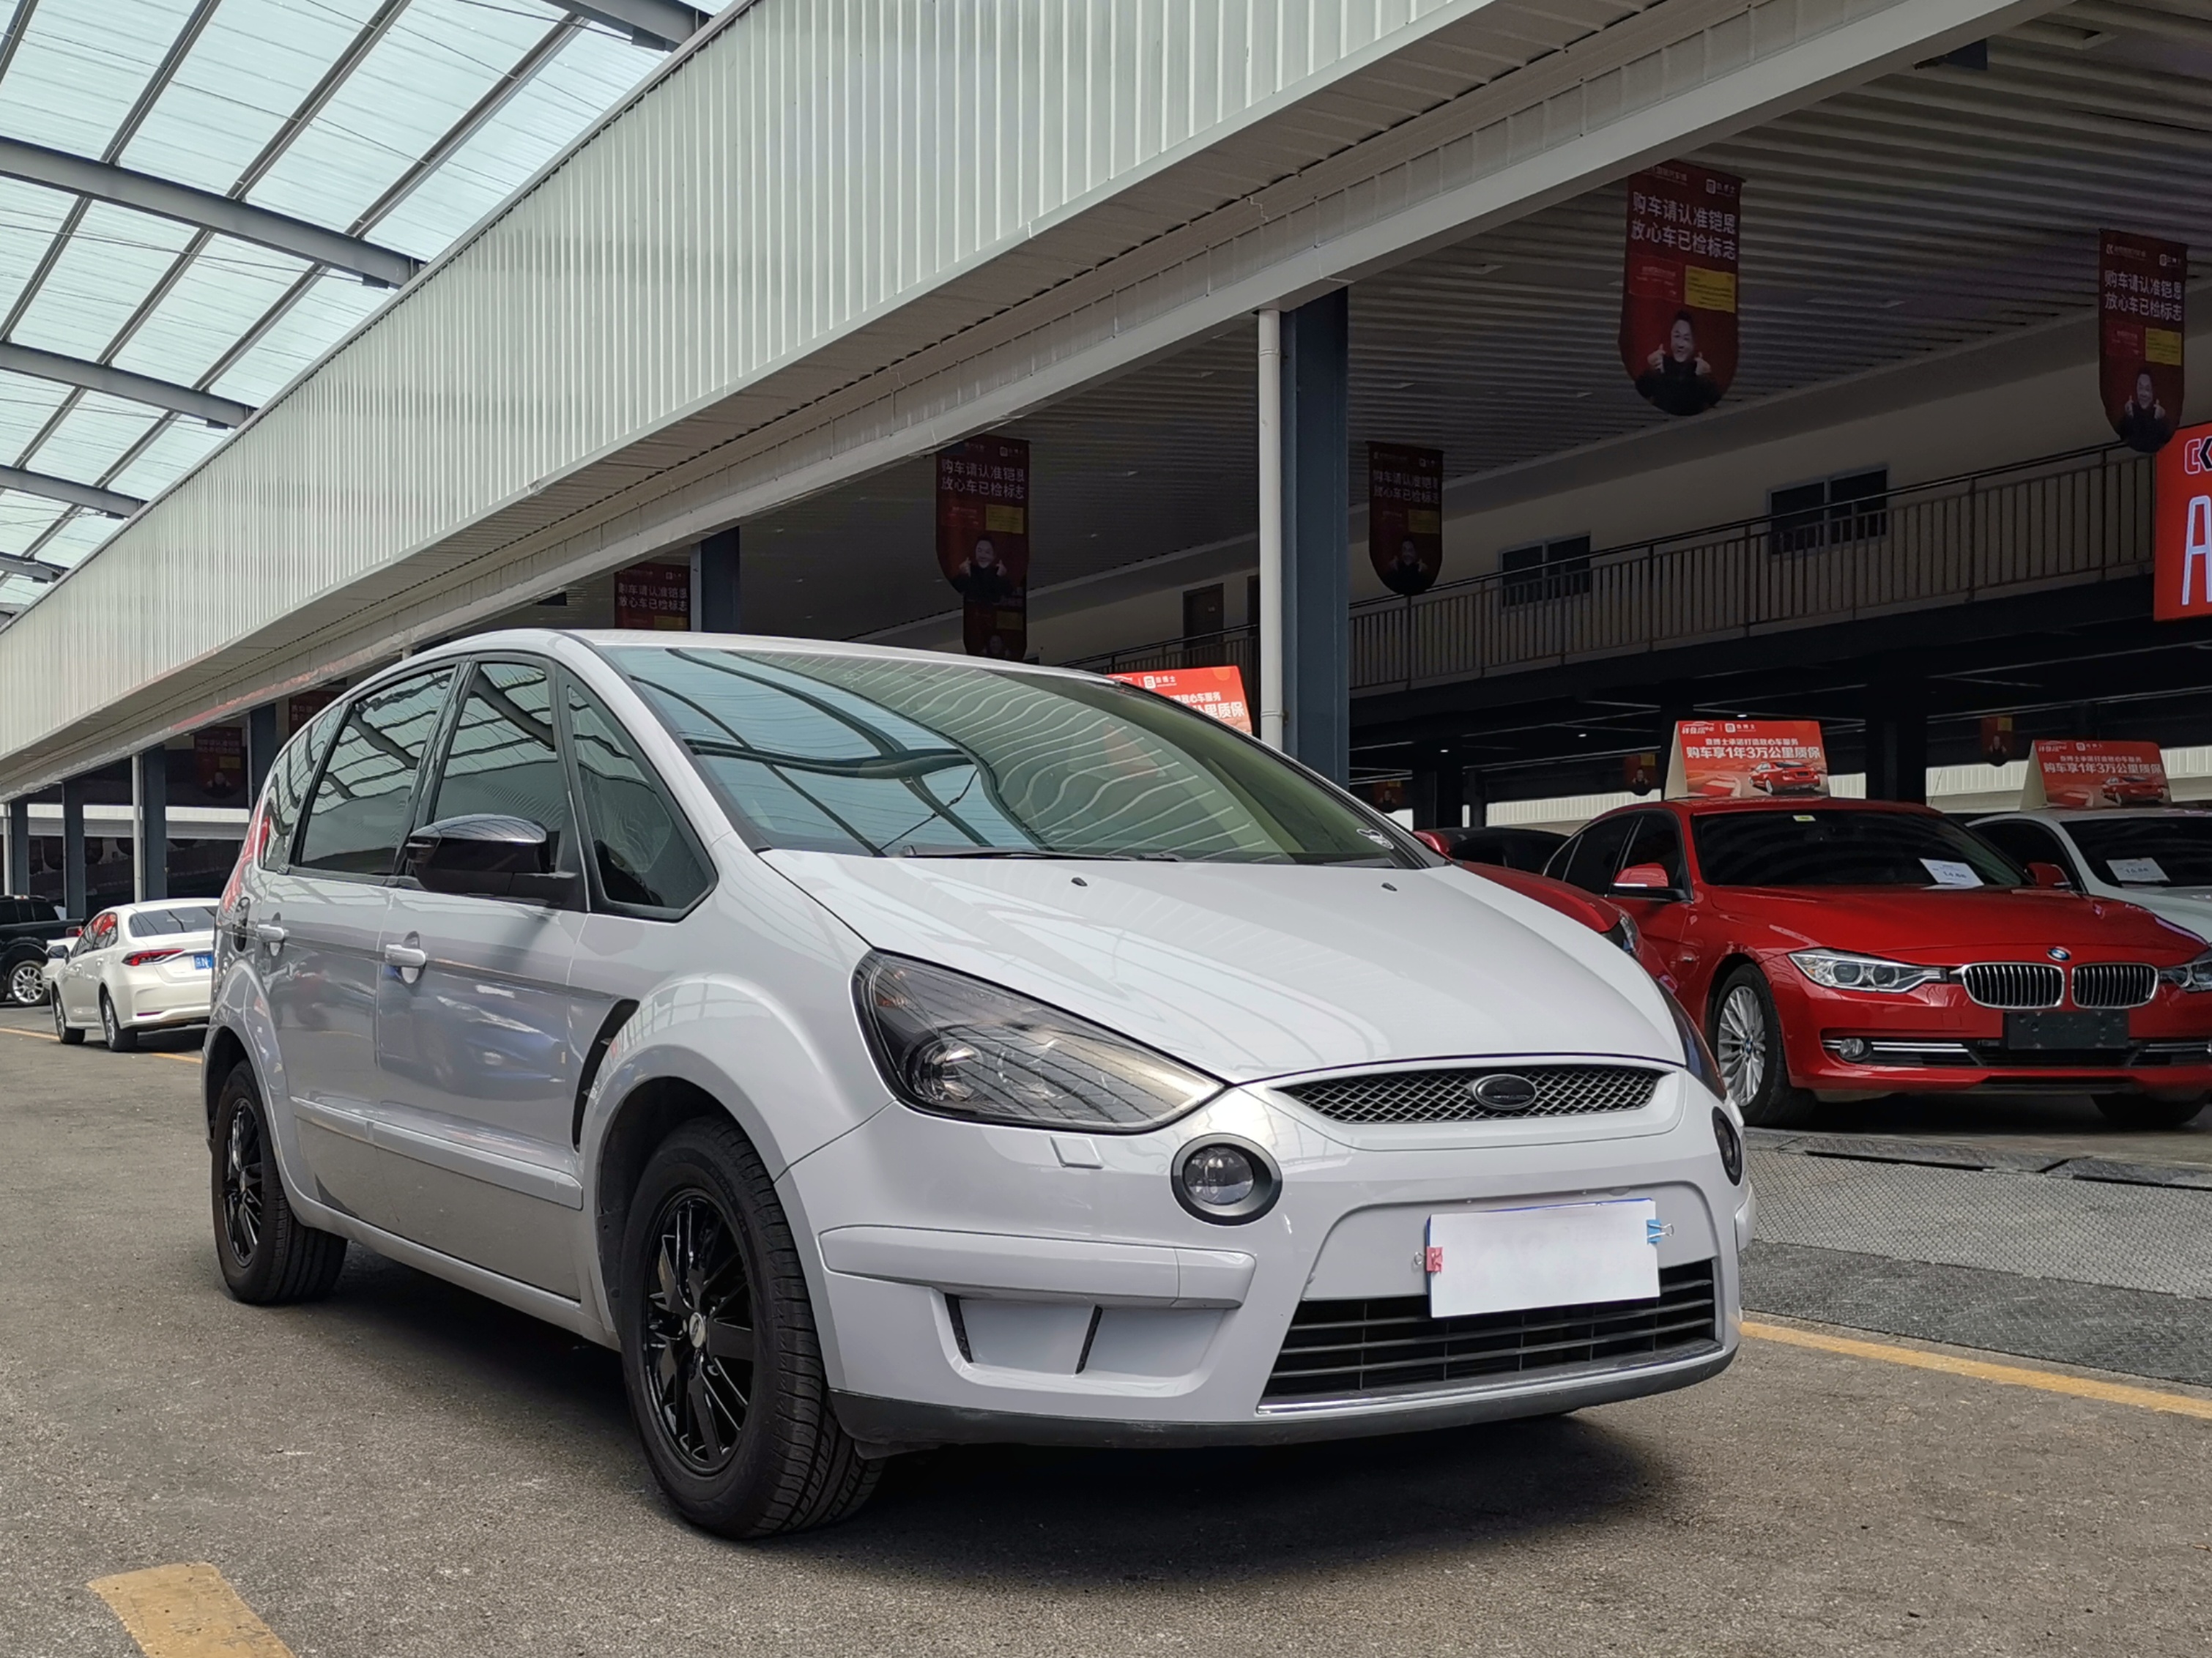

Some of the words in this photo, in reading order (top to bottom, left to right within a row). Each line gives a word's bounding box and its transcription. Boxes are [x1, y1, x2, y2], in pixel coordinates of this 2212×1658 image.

[1633, 191, 1737, 234] 购车请认准铠恩
[1630, 219, 1737, 261] 放心车已检标志
[2104, 269, 2182, 300] 购车请认准铠恩
[2104, 291, 2182, 321] 放心车已检标志
[940, 476, 1025, 499] 放心车已检标志
[1686, 746, 1821, 759] 购车享1年3万公里质保
[2043, 762, 2162, 774] 购车享1年3万公里质保
